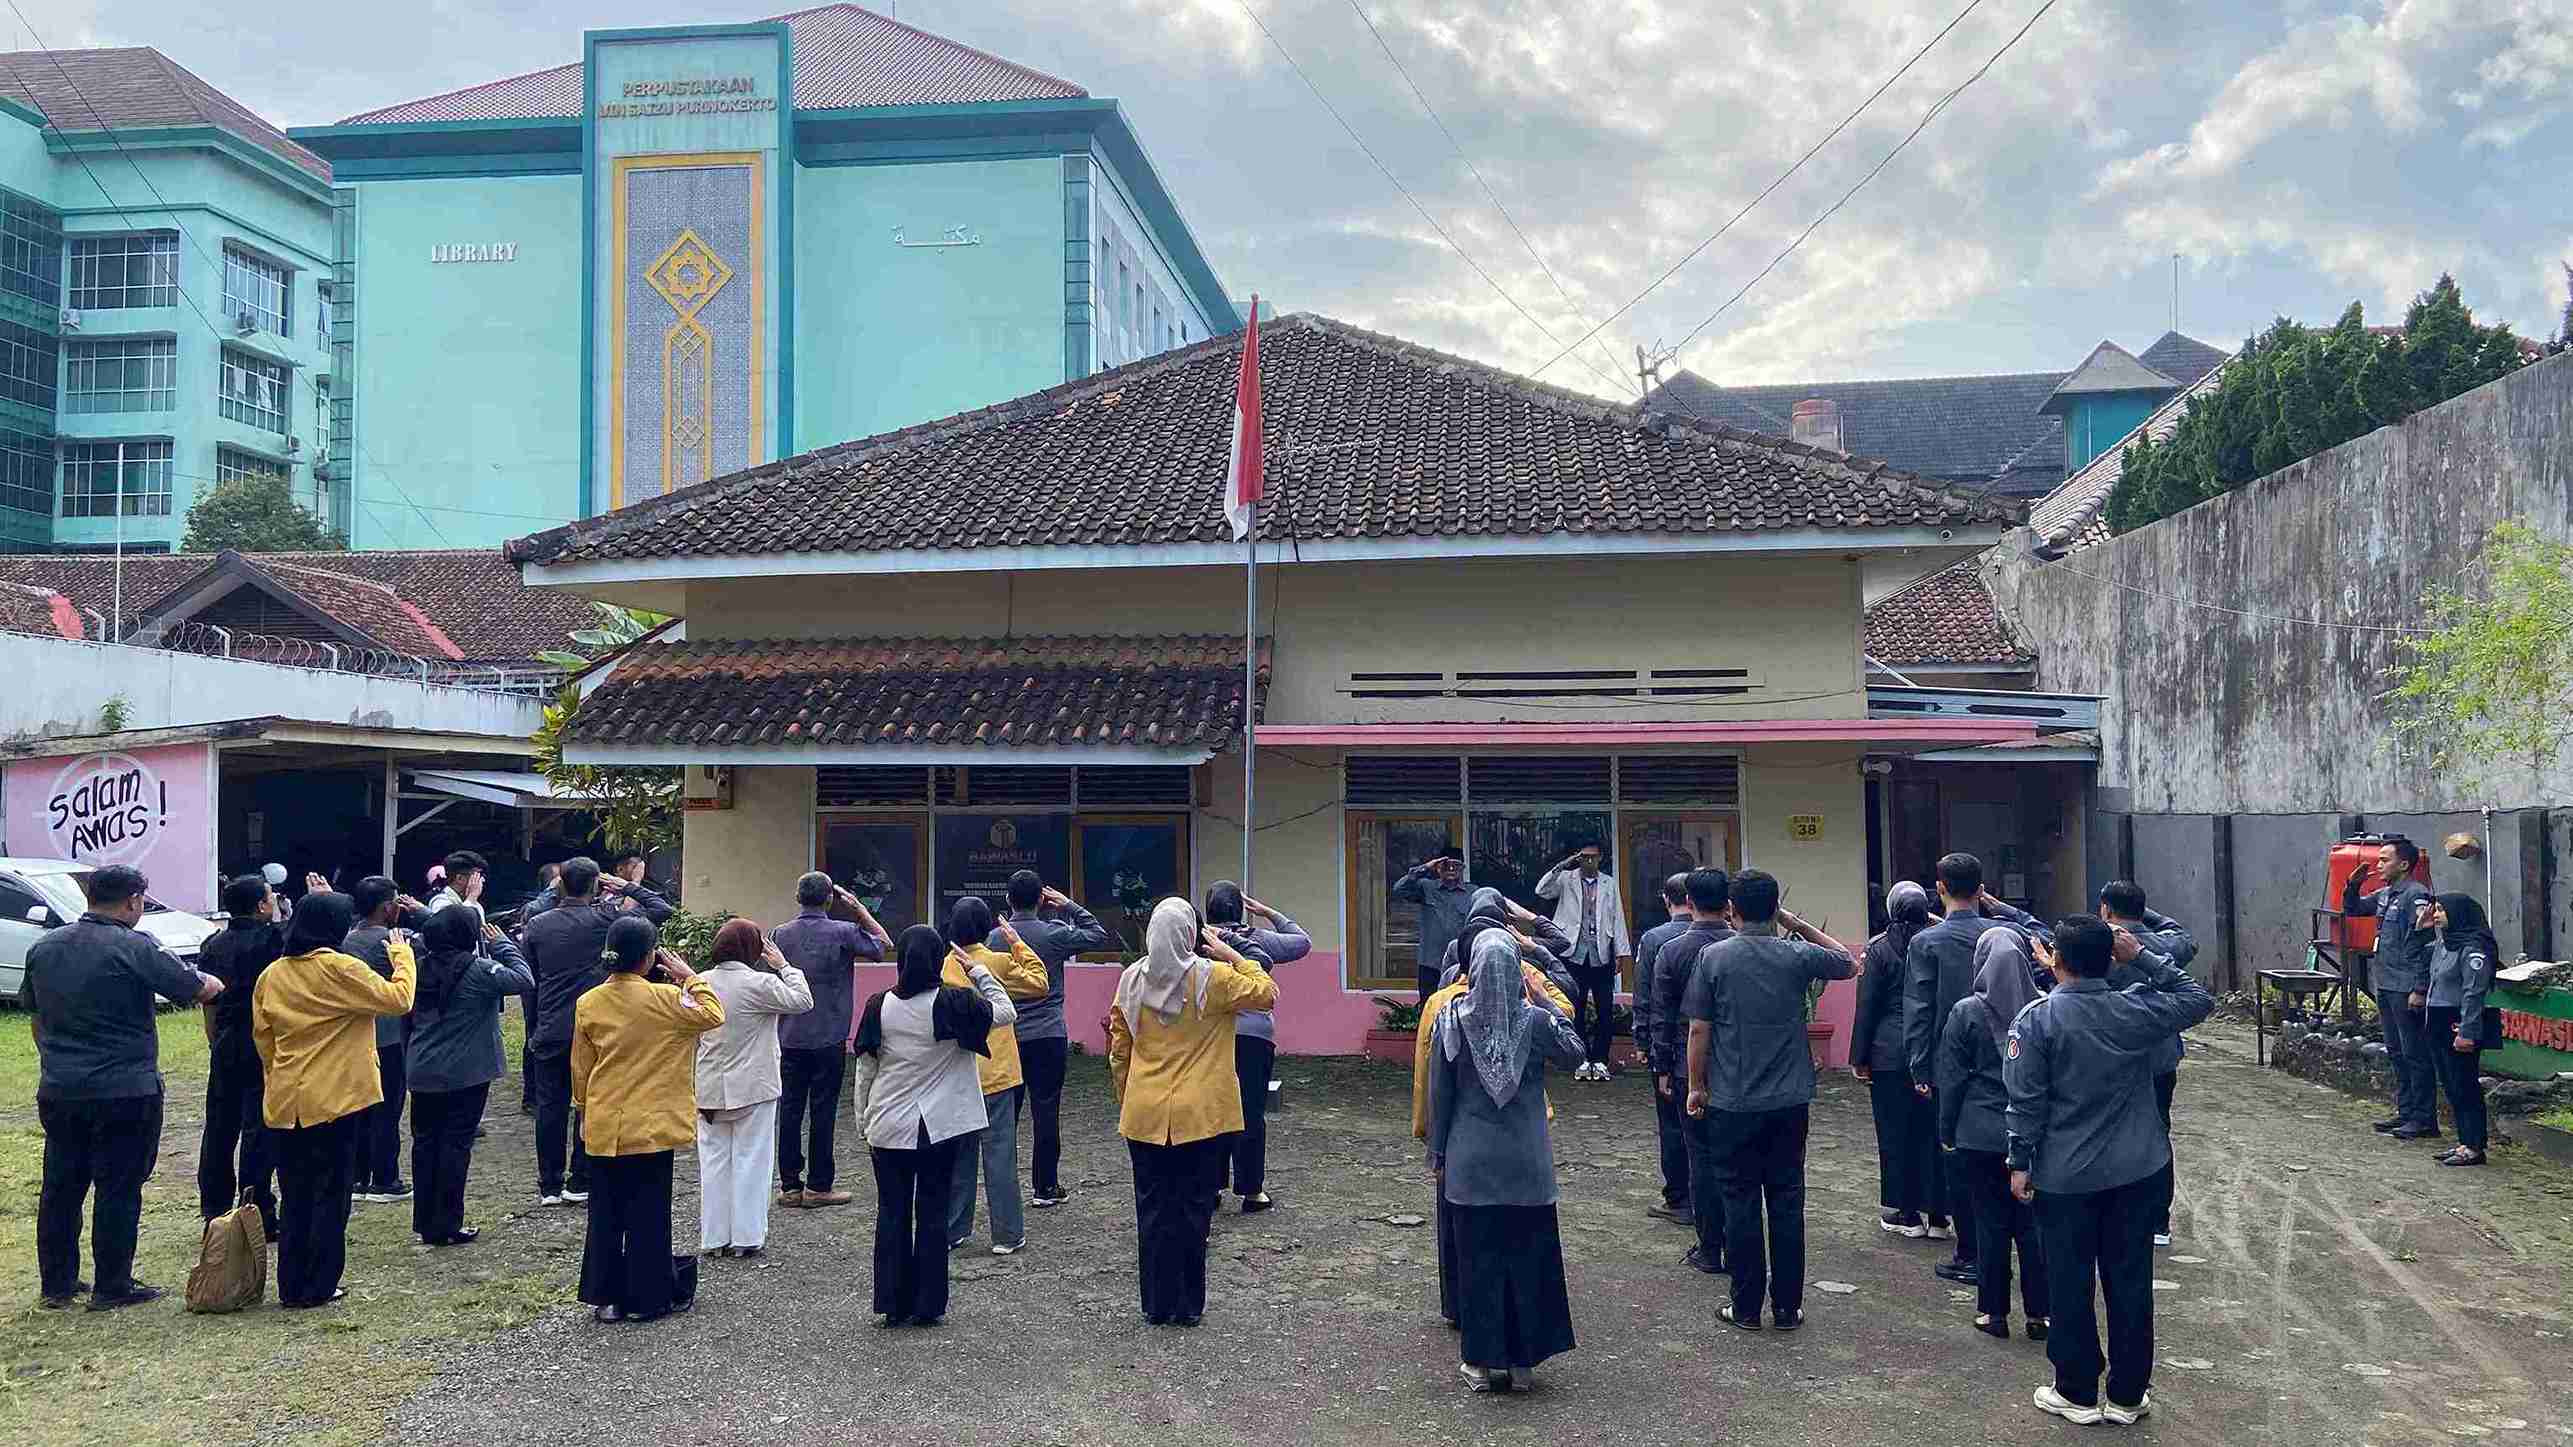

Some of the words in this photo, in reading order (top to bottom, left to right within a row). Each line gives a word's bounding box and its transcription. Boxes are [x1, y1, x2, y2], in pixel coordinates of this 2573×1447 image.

[623, 77, 755, 97] PERPUSTAKAAN
[676, 97, 777, 115] PURWOKERTO
[431, 243, 518, 263] LIBRARY
[1797, 823, 1817, 836] 38
